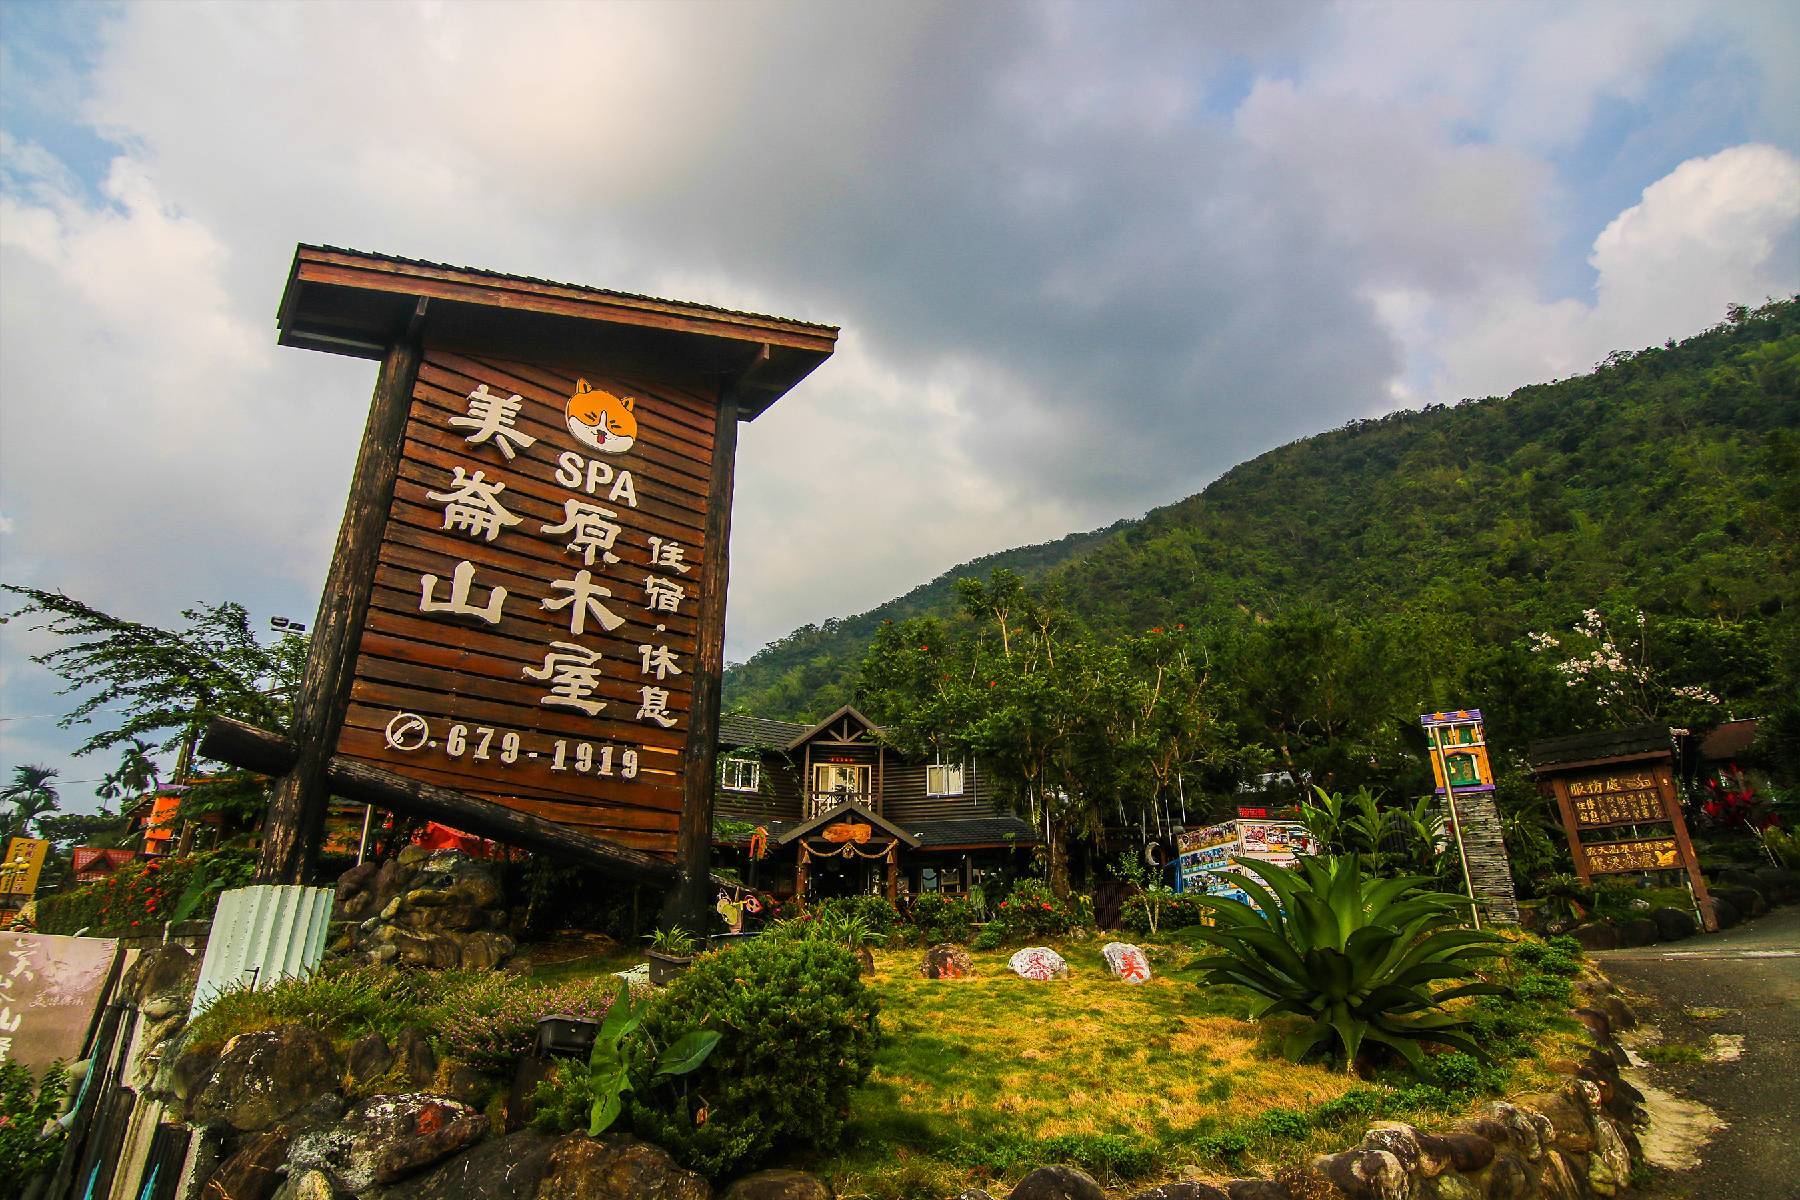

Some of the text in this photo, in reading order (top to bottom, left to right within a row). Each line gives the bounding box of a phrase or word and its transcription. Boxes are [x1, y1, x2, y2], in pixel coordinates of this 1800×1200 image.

[555, 452, 638, 508] SPA
[522, 498, 626, 717] 原木屋
[446, 724, 639, 780] 679-1919
